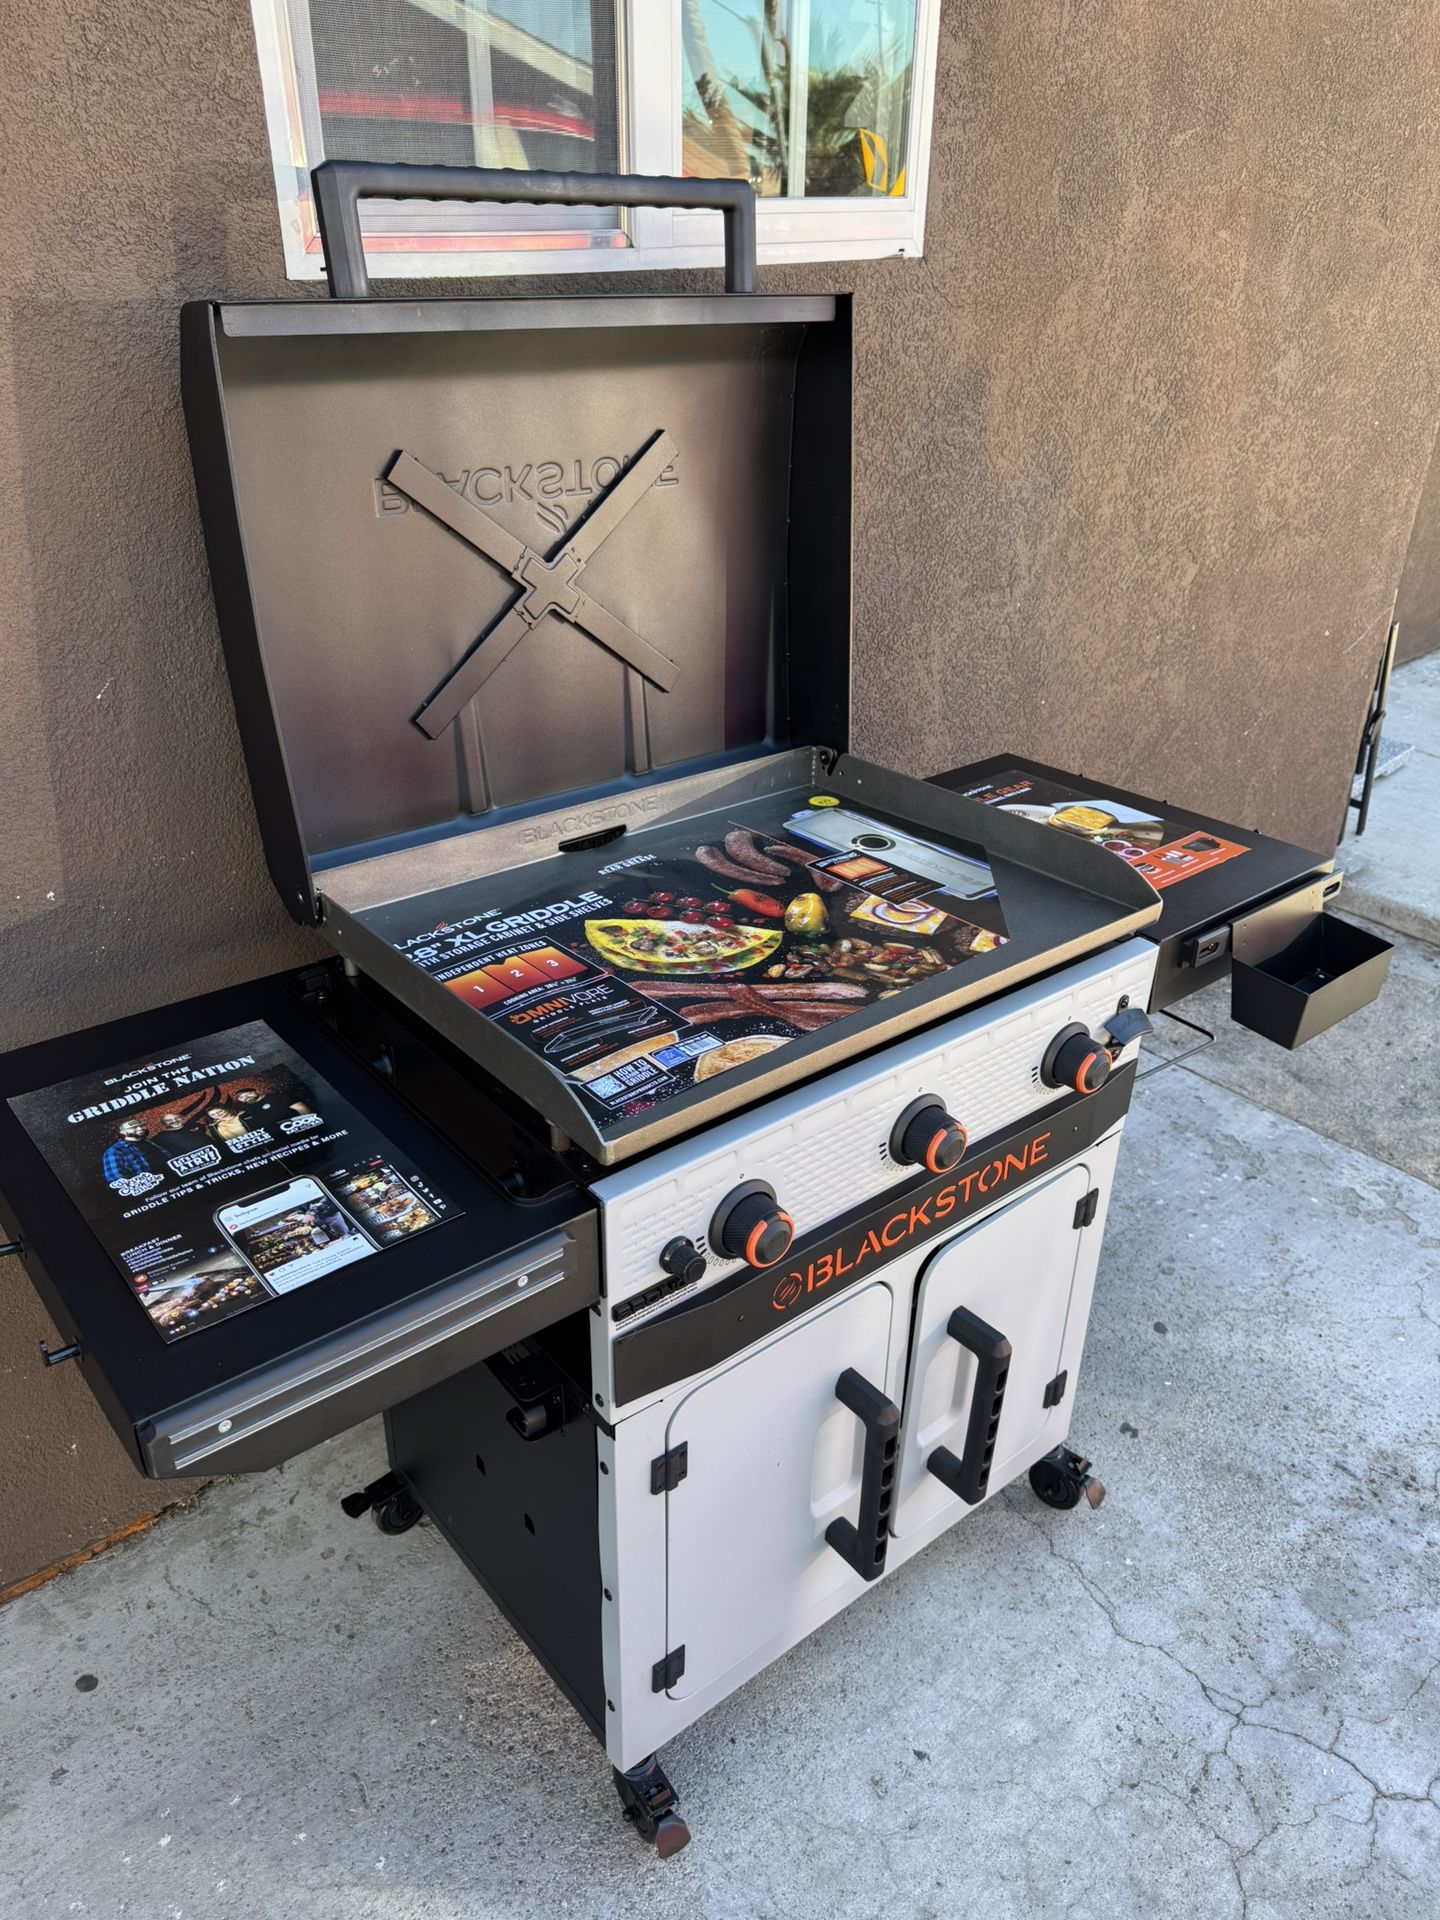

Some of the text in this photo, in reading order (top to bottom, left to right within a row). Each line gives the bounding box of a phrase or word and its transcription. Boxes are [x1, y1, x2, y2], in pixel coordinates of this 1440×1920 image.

[519, 796, 659, 844] BLACKSTONE
[393, 908, 501, 950] LACKSTONE
[417, 898, 614, 968] ITH STORAGE CABINET & SIDE SHELVES
[444, 931, 490, 947] XL
[485, 891, 604, 932] GRIDDLE
[434, 940, 548, 982] INDEPENDENT HEAT ZONES
[473, 959, 560, 993] 1 2 3
[503, 992, 529, 1006] COOKING
[509, 984, 614, 1024] OMNIVORE
[532, 1005, 576, 1023] GRIDDLE
[578, 995, 608, 1006] PLATE
[104, 1053, 192, 1087] BLACKSTONE
[124, 1066, 192, 1093] JOIN THE
[613, 1059, 647, 1077] HOW TO
[625, 1067, 659, 1087] GRIDDLE
[67, 1055, 256, 1124] GRIDDLE NATION
[225, 1127, 265, 1146] FAMILY
[235, 1133, 272, 1150] STYLE
[123, 1196, 170, 1219] GRIDDLE
[169, 1187, 194, 1200] TIPS
[204, 1167, 246, 1186] TRICKS,
[245, 1159, 269, 1171] NEW
[269, 1143, 311, 1162] RECIPES
[320, 1129, 349, 1143] MORE
[144, 1191, 168, 1203] Follow
[180, 1179, 199, 1189] team
[206, 1162, 243, 1179] Blackstone
[243, 1156, 262, 1165] chefs
[270, 1144, 290, 1155] social
[289, 1139, 310, 1148] media
[806, 1131, 1052, 1293] BLACKSTONE
[120, 1237, 160, 1257] BREAKFAST
[122, 1247, 148, 1261] LUNCH
[155, 1233, 183, 1247] DINNER
